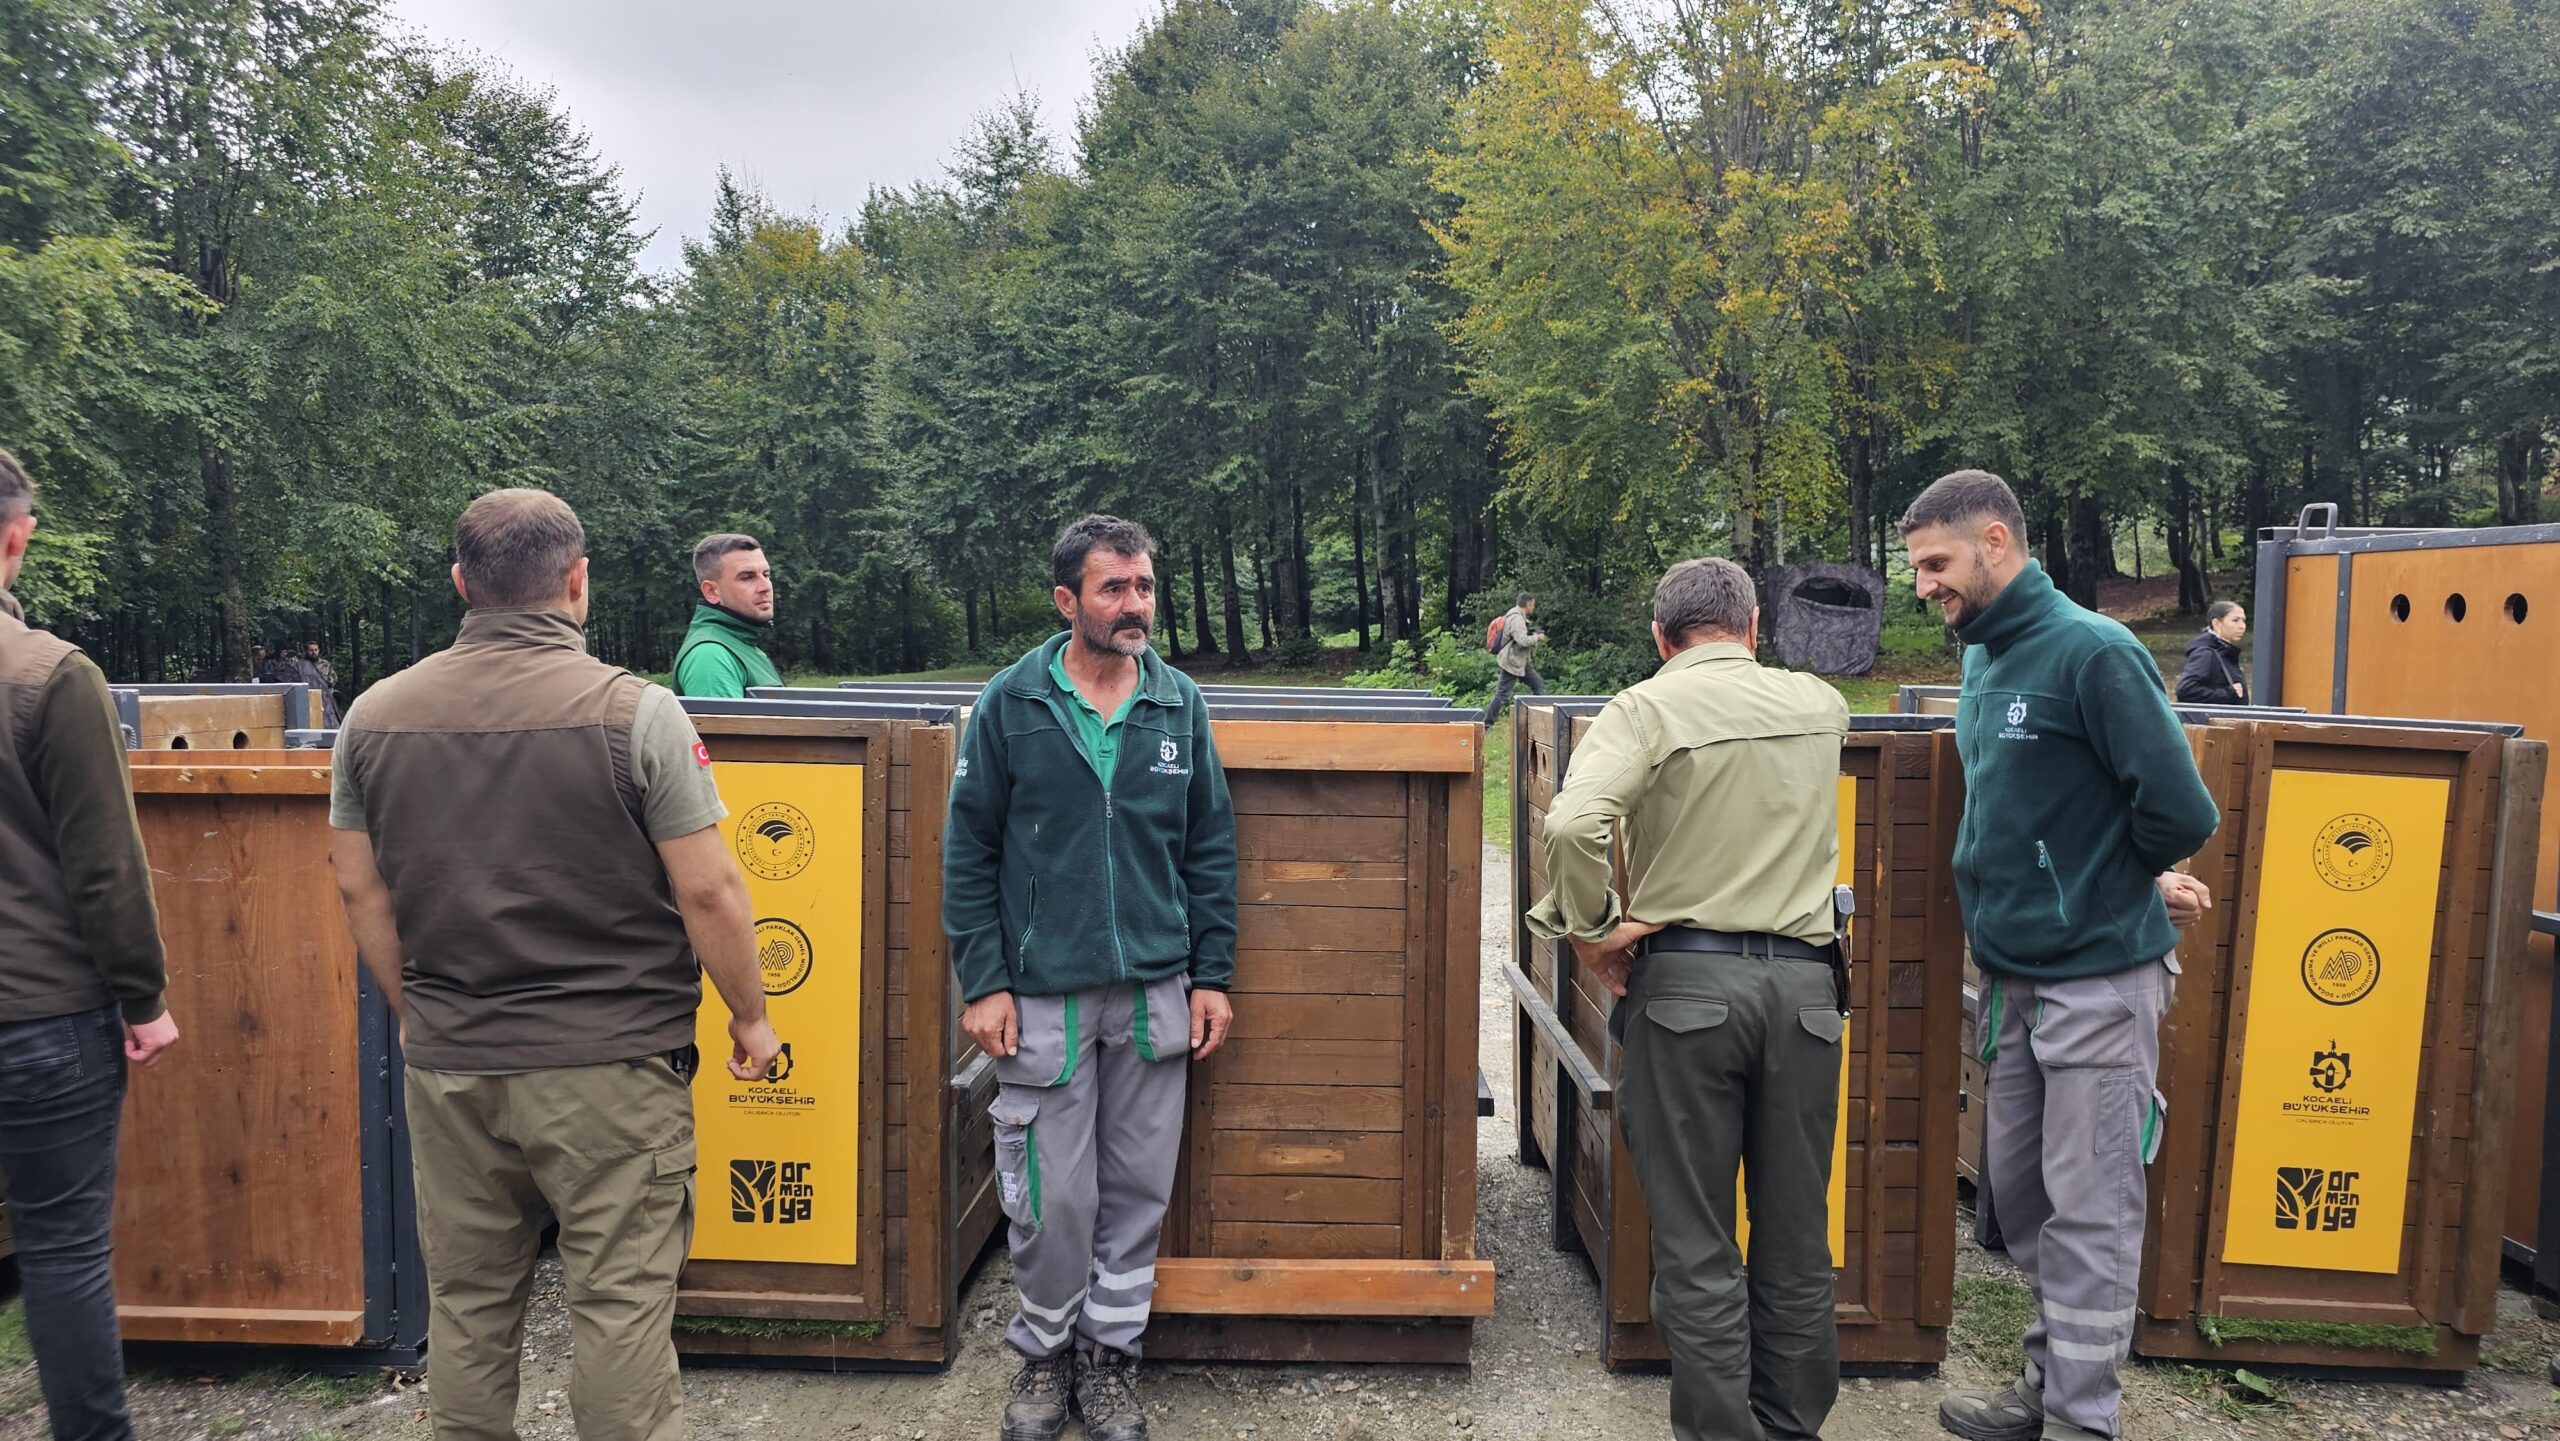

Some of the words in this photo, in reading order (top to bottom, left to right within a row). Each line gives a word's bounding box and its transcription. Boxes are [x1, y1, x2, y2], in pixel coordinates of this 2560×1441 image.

[781, 1162, 811, 1183] or
[2328, 1171, 2360, 1191] or
[779, 1183, 814, 1197] man
[2325, 1192, 2360, 1206] man
[779, 1197, 812, 1224] ya
[2322, 1206, 2357, 1232] ya
